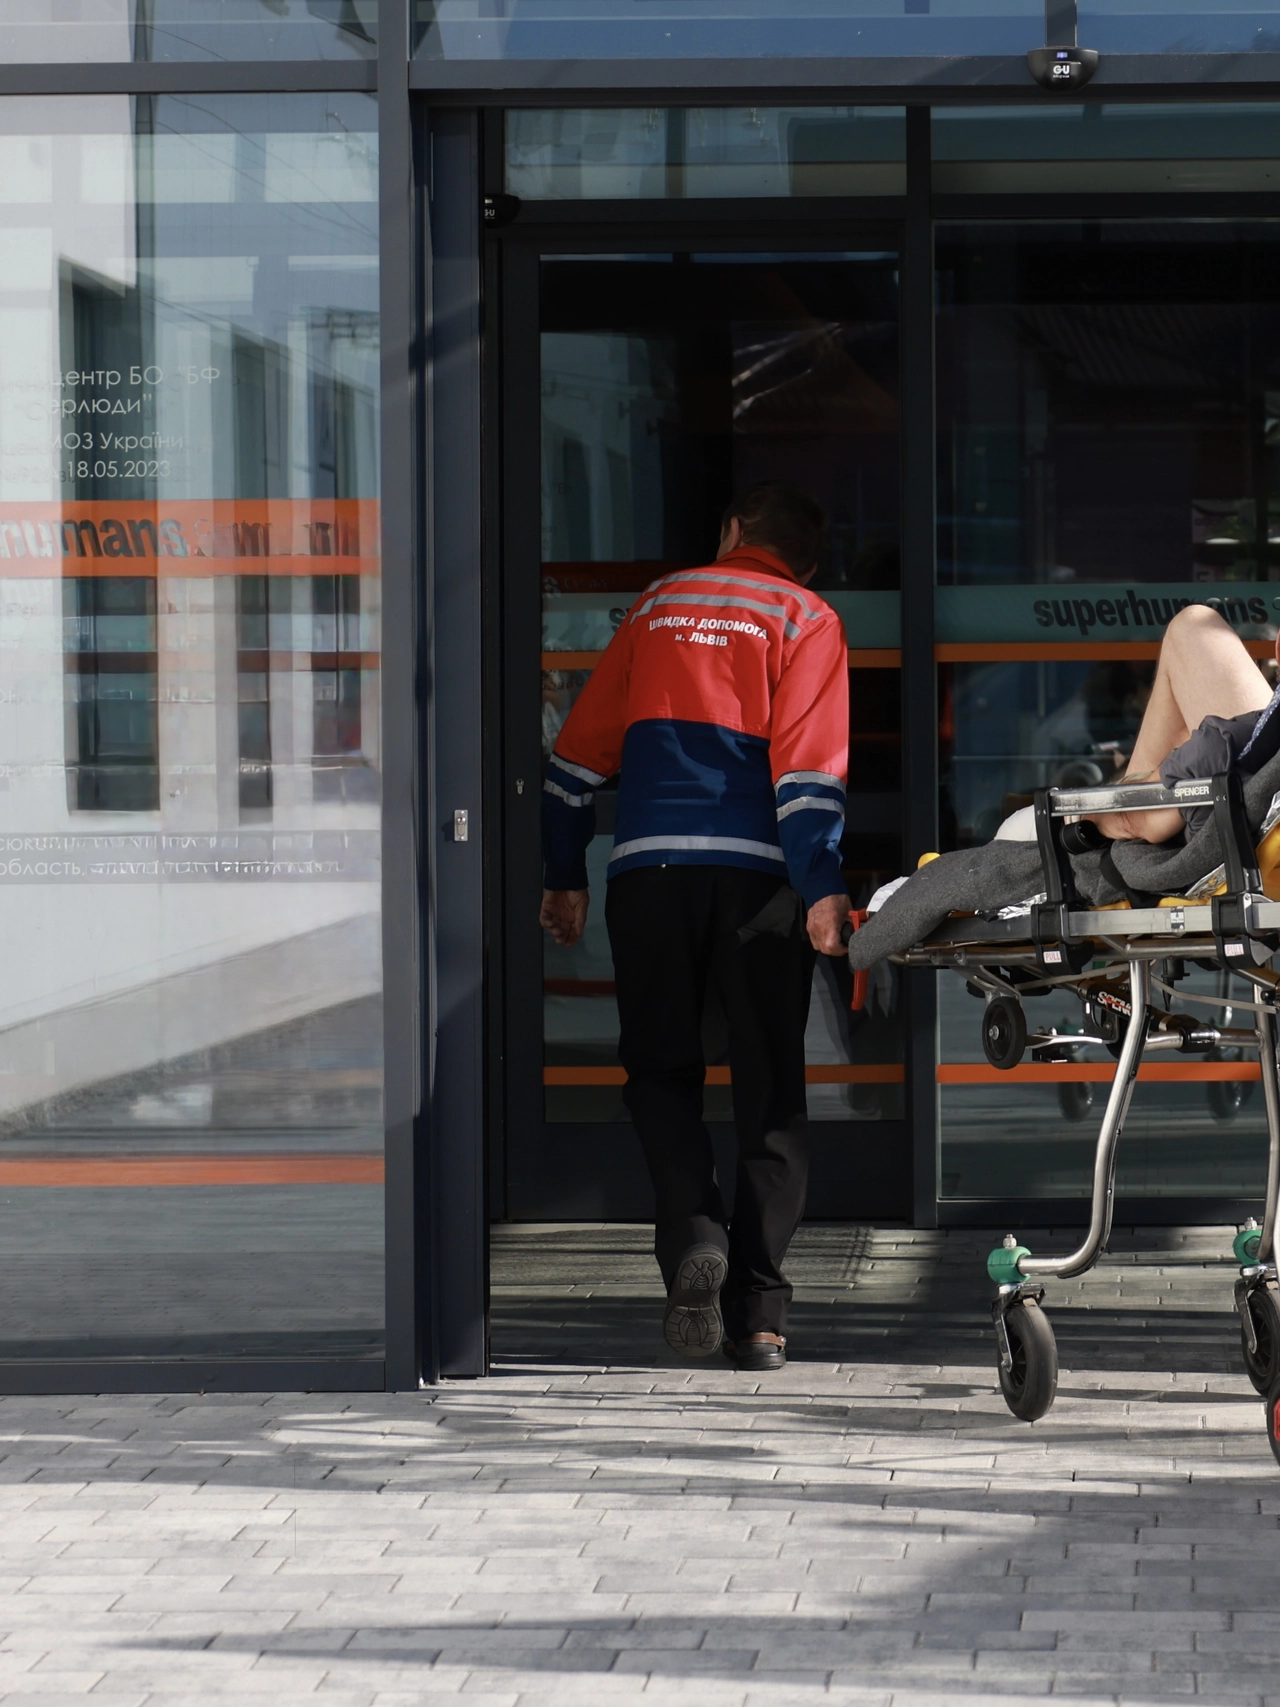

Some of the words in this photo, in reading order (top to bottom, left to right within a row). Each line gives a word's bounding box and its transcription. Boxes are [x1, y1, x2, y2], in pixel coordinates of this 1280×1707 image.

[130, 365, 163, 385] БО
[100, 432, 183, 453] України
[68, 460, 171, 478] 18.05.2023
[649, 616, 695, 631] ШВИДКА
[697, 618, 767, 639] ДОПОМОГА
[689, 631, 728, 646] ЛЬВІВ
[1174, 785, 1210, 798] SPENCER
[1045, 952, 1060, 962] PULL
